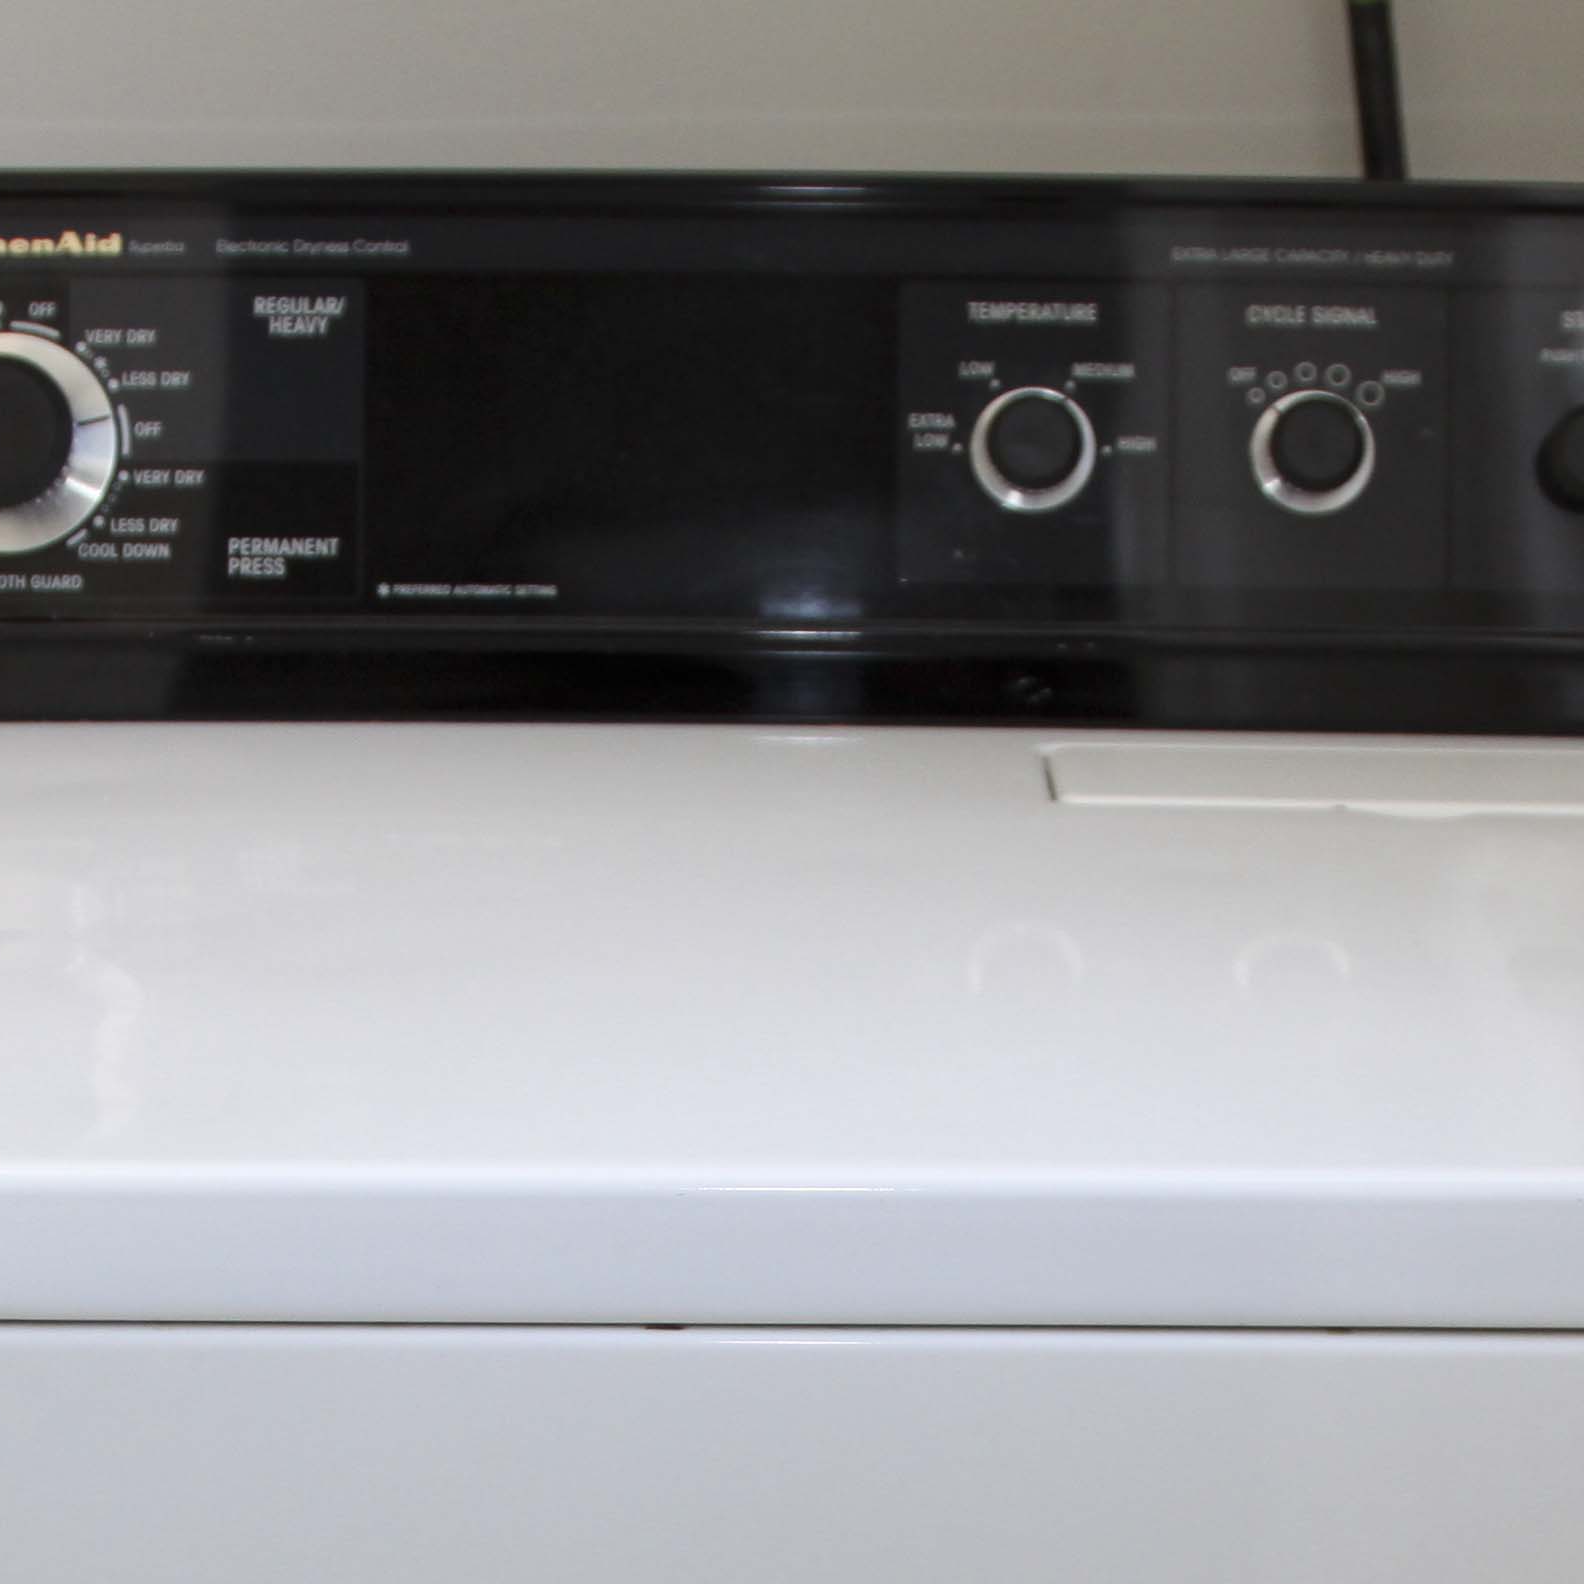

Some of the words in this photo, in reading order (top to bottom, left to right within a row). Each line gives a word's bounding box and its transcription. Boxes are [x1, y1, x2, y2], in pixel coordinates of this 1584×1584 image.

[216, 239, 289, 253] Electronic
[293, 239, 349, 255] Dryness
[352, 239, 409, 253] Control
[1171, 247, 1217, 262] EXTRA
[1221, 248, 1268, 263] LARGE
[29, 302, 57, 317] OFF
[253, 296, 346, 315] REGULAR/
[968, 301, 1098, 322] TEMPERATURE
[1245, 304, 1306, 324] CYCLE
[1311, 304, 1378, 325] SIGNAL
[269, 316, 328, 335] HEAVY
[83, 329, 122, 344] VERY
[126, 329, 157, 344] DRY
[958, 361, 996, 378] LOW
[1071, 363, 1135, 379] MEDIUM
[1382, 370, 1422, 385] HIGH
[121, 370, 156, 387] LESS
[160, 370, 191, 387] DRY
[907, 413, 956, 429] EXTRA
[134, 421, 163, 438] OFF
[913, 433, 950, 449] LOW
[1117, 436, 1157, 452] HIGH
[133, 470, 170, 485] VERY
[174, 470, 206, 485] DRY
[110, 518, 145, 533] LESS
[149, 518, 179, 533] DRY
[78, 542, 118, 559] COOL
[122, 542, 172, 559] DOWN
[227, 537, 341, 557] PERMANENT
[227, 557, 287, 577] PRESS
[30, 574, 83, 590] GUARD
